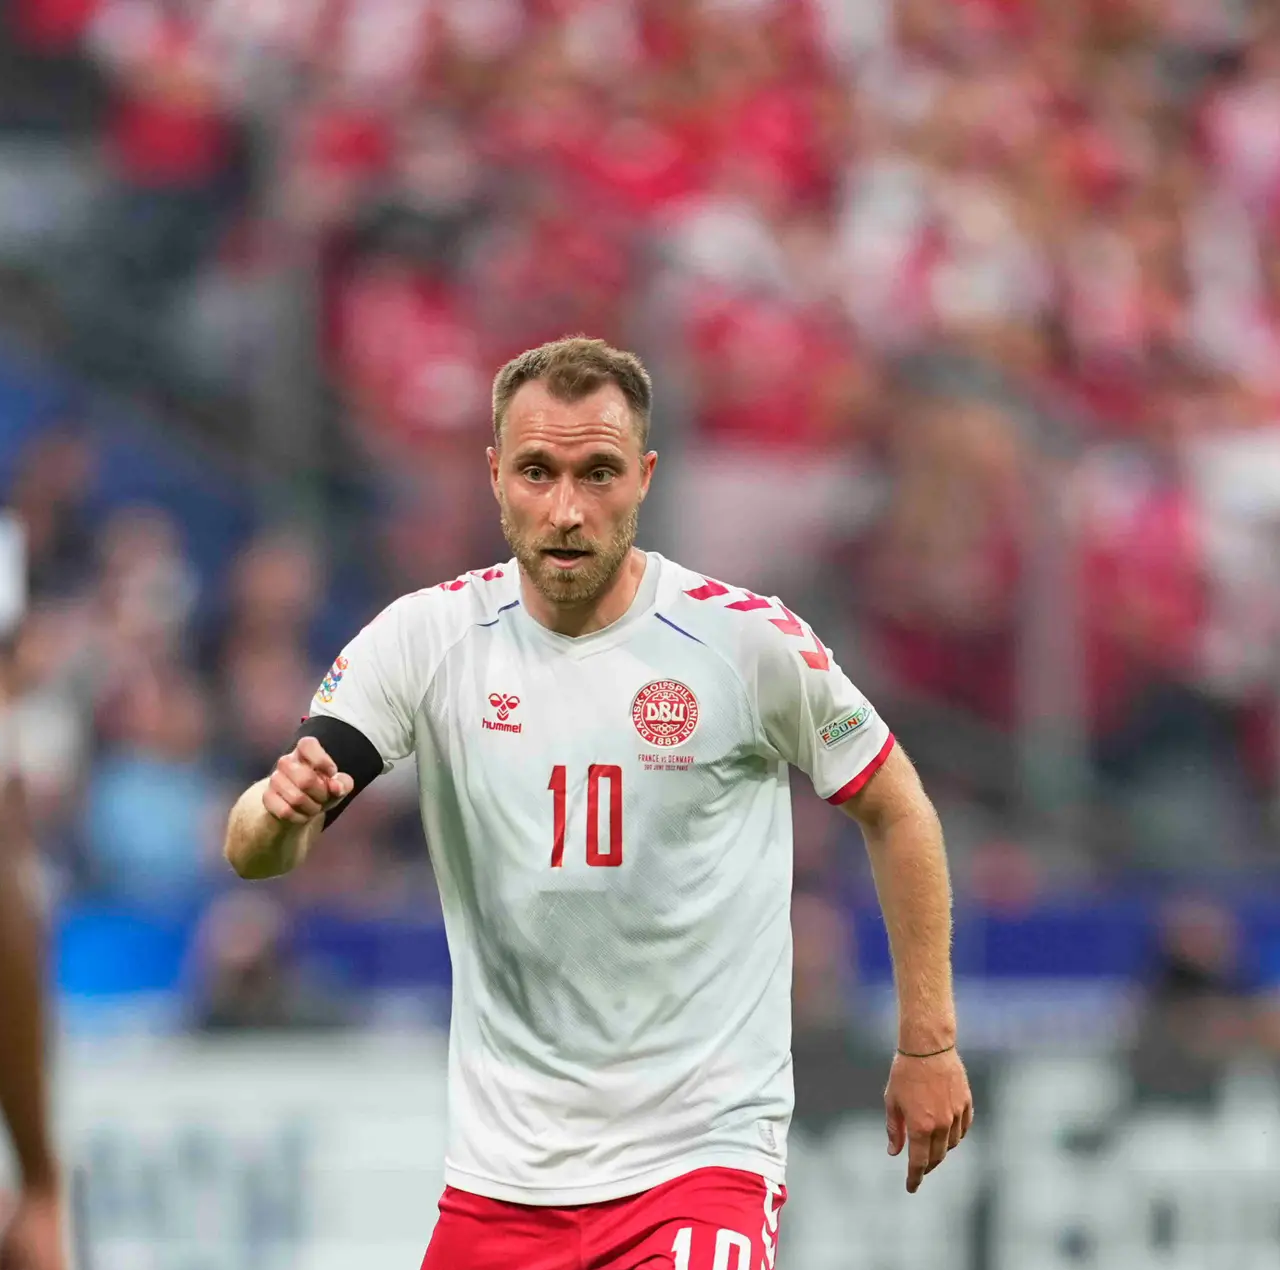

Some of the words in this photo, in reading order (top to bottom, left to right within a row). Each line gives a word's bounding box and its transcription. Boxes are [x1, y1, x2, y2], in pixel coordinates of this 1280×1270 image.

[645, 701, 686, 722] DBU
[482, 718, 522, 733] hummel
[651, 735, 680, 746] 1889
[638, 754, 660, 762] FRANCE
[668, 755, 695, 763] DENMARK
[547, 764, 623, 867] 10
